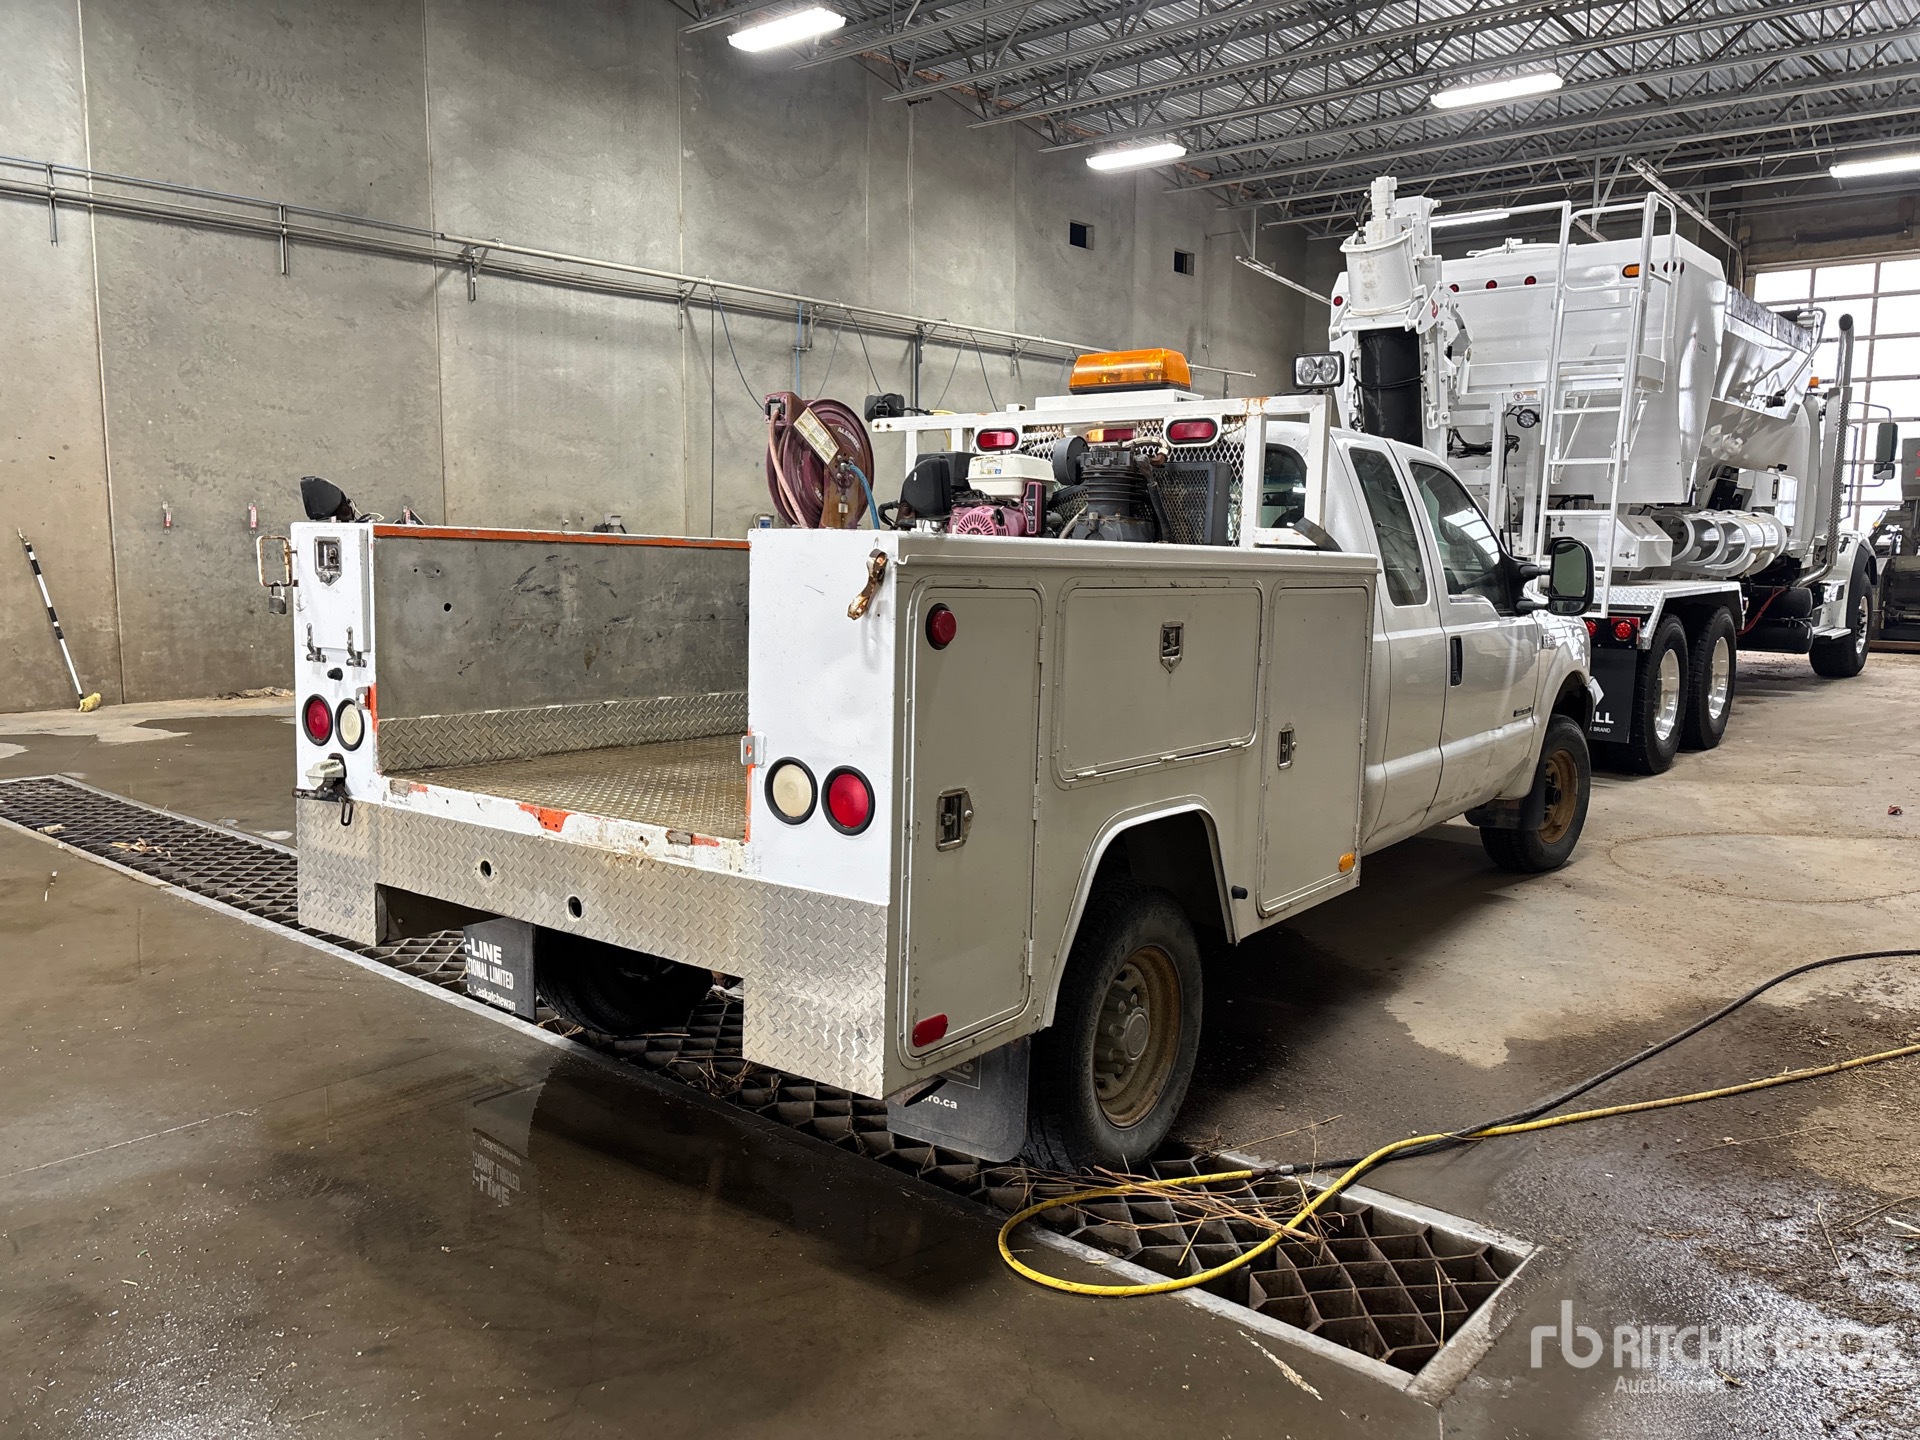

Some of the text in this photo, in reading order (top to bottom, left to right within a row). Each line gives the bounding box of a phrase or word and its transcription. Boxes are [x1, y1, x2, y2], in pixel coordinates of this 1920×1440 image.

[1592, 711, 1614, 724] LL
[466, 957, 514, 990] TIONAL LIMITED
